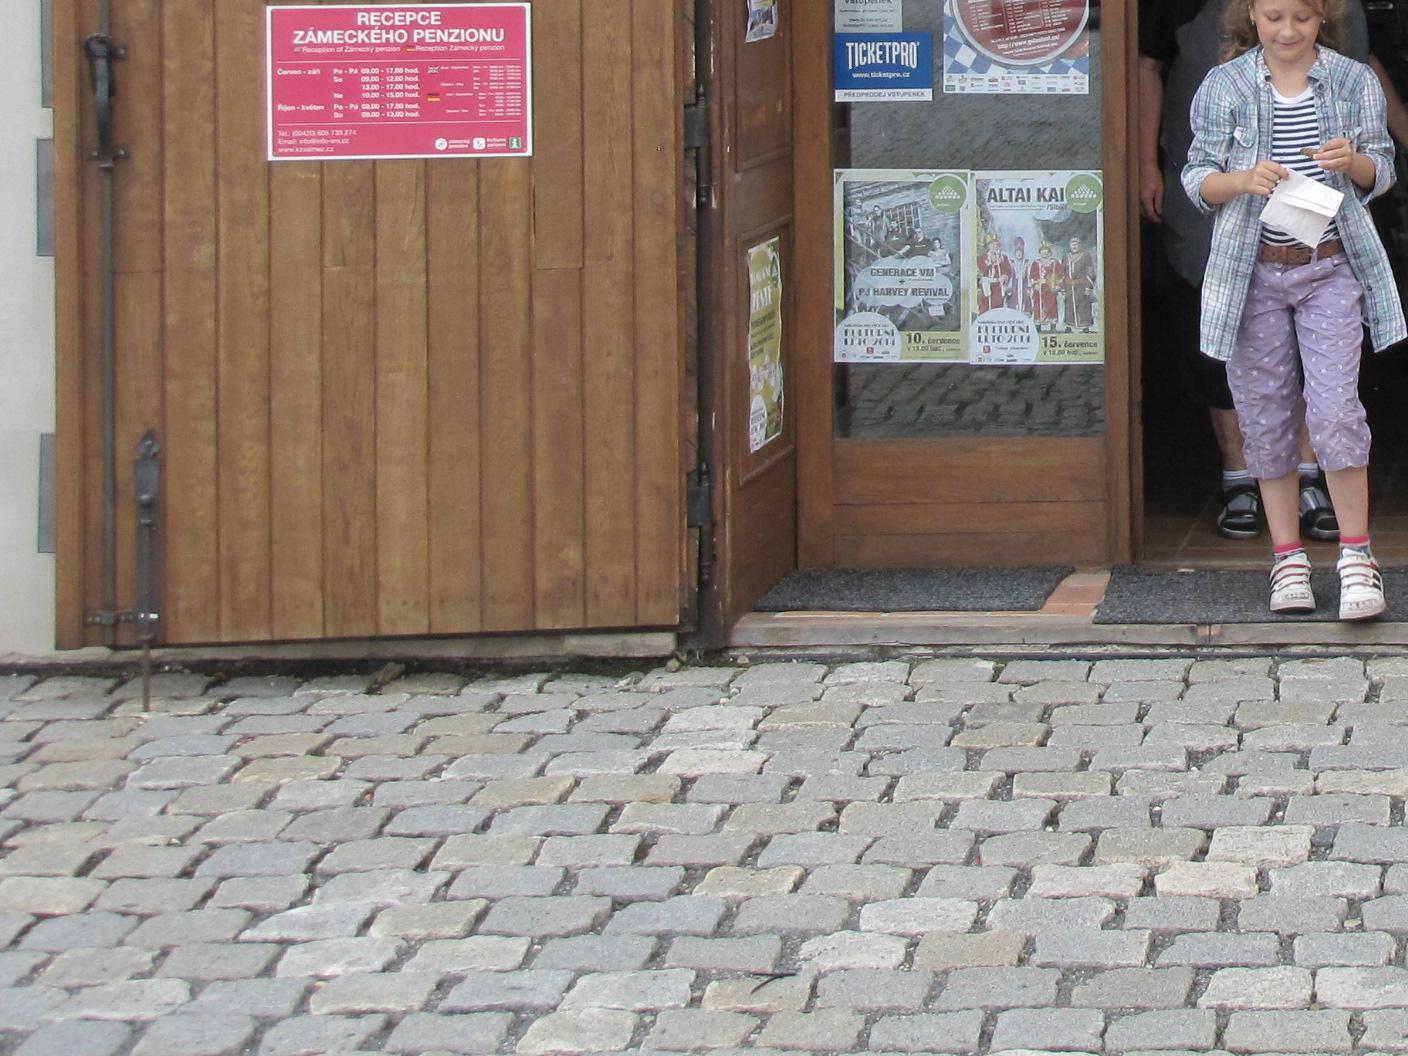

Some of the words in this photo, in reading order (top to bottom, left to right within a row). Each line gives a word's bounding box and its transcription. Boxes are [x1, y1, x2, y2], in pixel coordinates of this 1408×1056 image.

[357, 11, 442, 27] RECEPCE
[293, 27, 408, 45] ZÁMECKÉHO
[413, 28, 505, 43] PENZIONU
[845, 40, 917, 71] TICKETPRO
[852, 70, 910, 79] www.ticketpro.cz
[987, 187, 1031, 203] ALTAI
[1037, 187, 1065, 203] KAI
[870, 267, 918, 277] GENERACE
[919, 267, 934, 277] VM
[858, 287, 870, 297] PJ
[873, 287, 909, 297] HARVEY
[911, 287, 949, 297] REVIVAL
[906, 332, 925, 344] 10.
[1041, 336, 1062, 348] 15.
